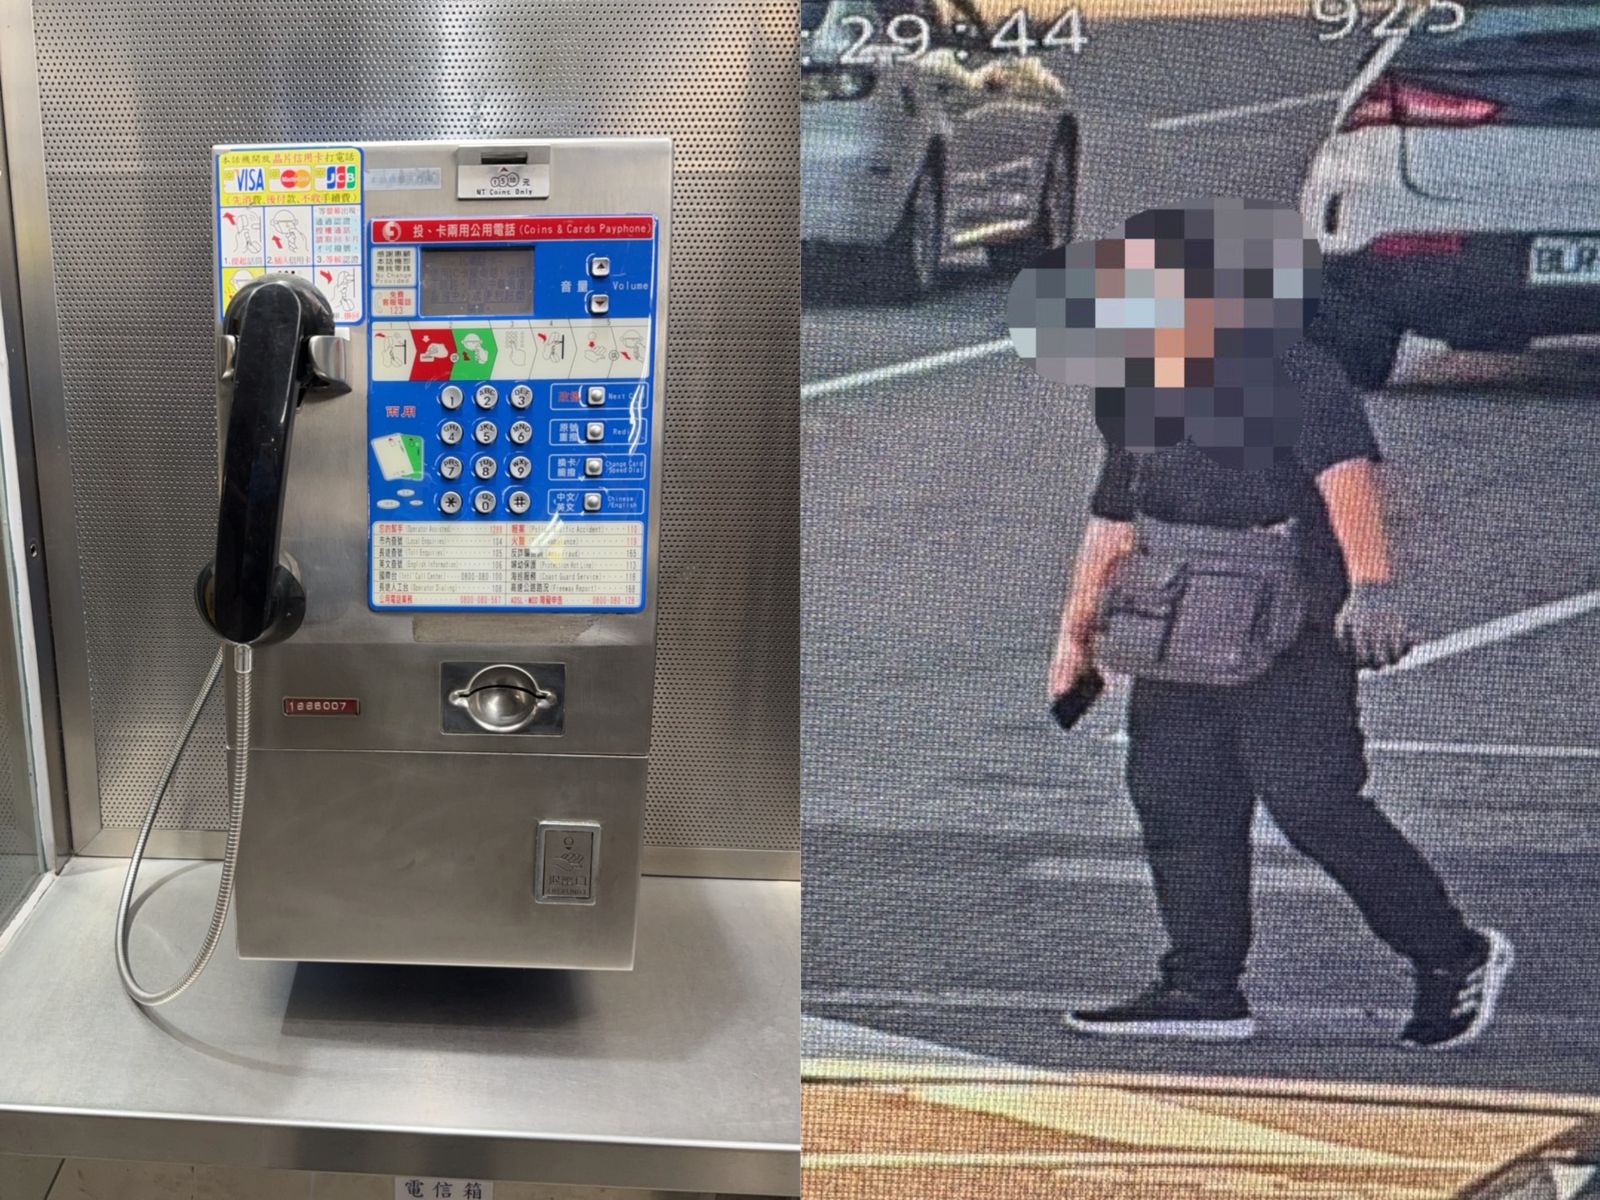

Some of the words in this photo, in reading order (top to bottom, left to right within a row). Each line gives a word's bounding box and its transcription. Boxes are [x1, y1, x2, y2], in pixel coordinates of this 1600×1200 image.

[237, 168, 265, 192] VISA
[326, 166, 356, 190] JCB
[515, 188, 533, 196] Only
[519, 224, 553, 235] (Coins
[556, 224, 563, 234] &
[566, 224, 596, 234] Cards
[600, 223, 652, 235] Payphone)
[612, 281, 649, 291] Volume
[450, 396, 454, 406] 1
[484, 396, 491, 406] 2
[518, 396, 526, 406] 3
[448, 432, 455, 440] 4
[484, 432, 490, 442] 5
[518, 432, 524, 442] 6
[448, 466, 455, 476] 7
[482, 466, 490, 476] 8
[517, 466, 524, 476] 9
[482, 501, 490, 510] 0
[405, 1179, 482, 1199] 電信箱
